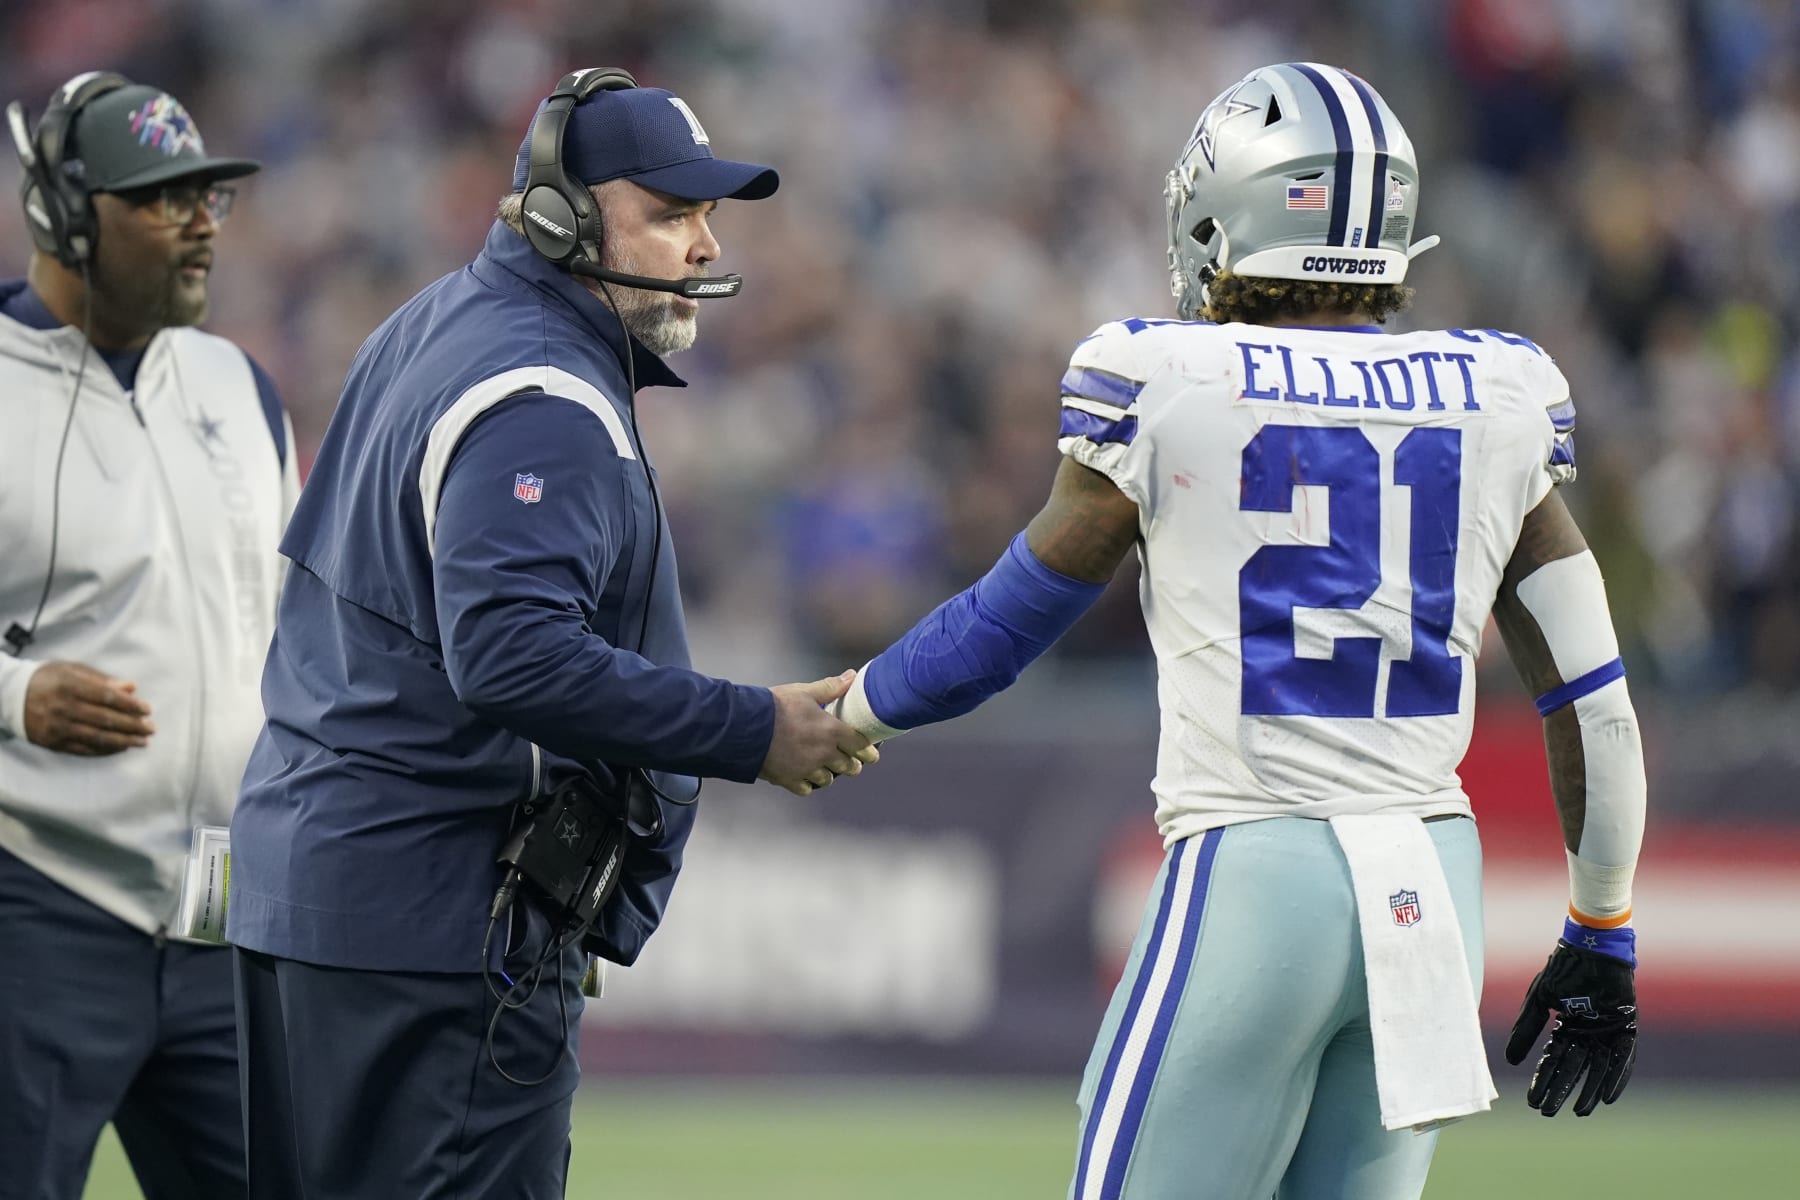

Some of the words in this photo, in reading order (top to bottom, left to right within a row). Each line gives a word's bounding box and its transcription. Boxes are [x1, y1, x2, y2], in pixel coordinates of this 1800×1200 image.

[524, 210, 574, 237] BOSE
[1302, 256, 1387, 275] COWBOYS
[687, 281, 739, 294] BOSE
[1235, 342, 1480, 411] ELLIOTT
[517, 484, 538, 499] NFL
[1238, 424, 1462, 718] 21
[592, 844, 618, 909] BOSE
[1393, 905, 1419, 924] NFL
